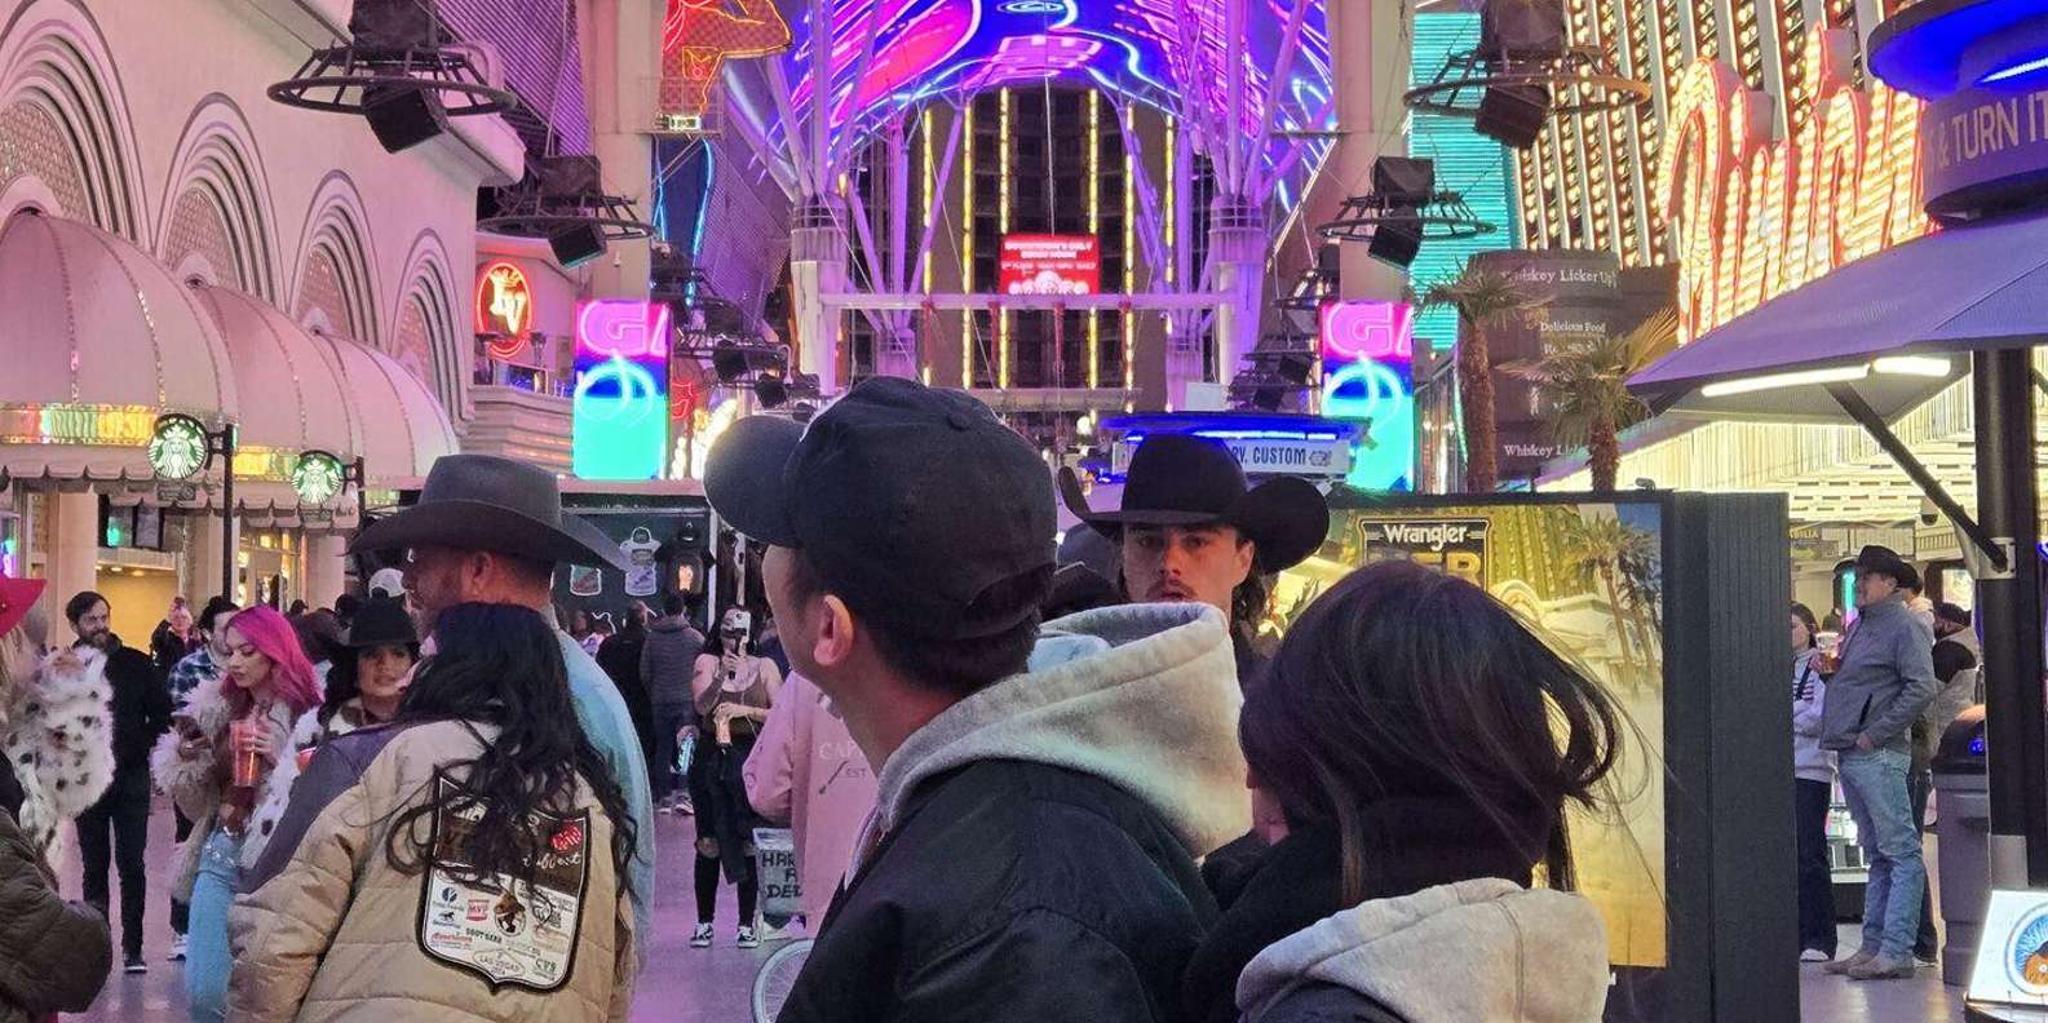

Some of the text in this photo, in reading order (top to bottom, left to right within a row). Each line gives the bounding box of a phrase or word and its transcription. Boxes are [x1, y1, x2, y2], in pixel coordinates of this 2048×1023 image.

[1952, 101, 2019, 162] TURN
[1560, 268, 1599, 283] Licker
[1541, 321, 1606, 332] Delicious Food
[1252, 446, 1306, 466] CUSTOM
[1505, 444, 1553, 458] Whiskey
[1384, 524, 1468, 551] Wrangler
